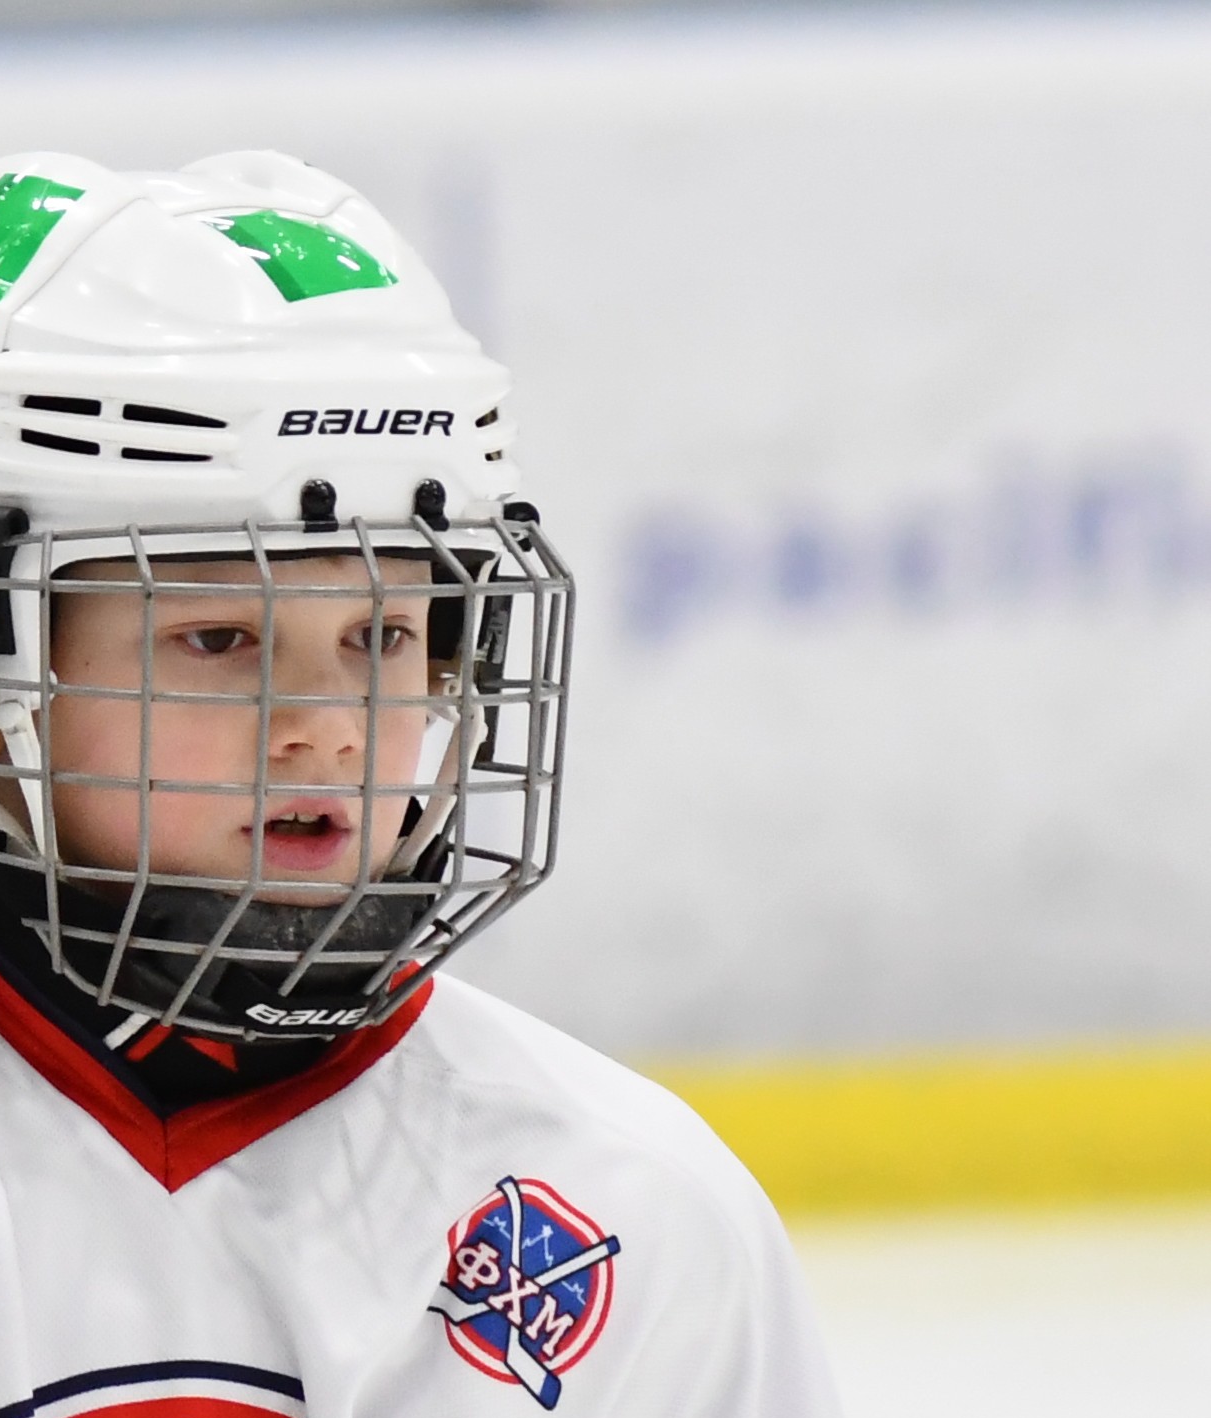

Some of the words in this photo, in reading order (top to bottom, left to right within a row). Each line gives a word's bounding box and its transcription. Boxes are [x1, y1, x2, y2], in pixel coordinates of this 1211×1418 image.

[277, 409, 455, 436] BAUER
[245, 1002, 369, 1026] BAUE
[454, 1241, 576, 1358] ФХМ
